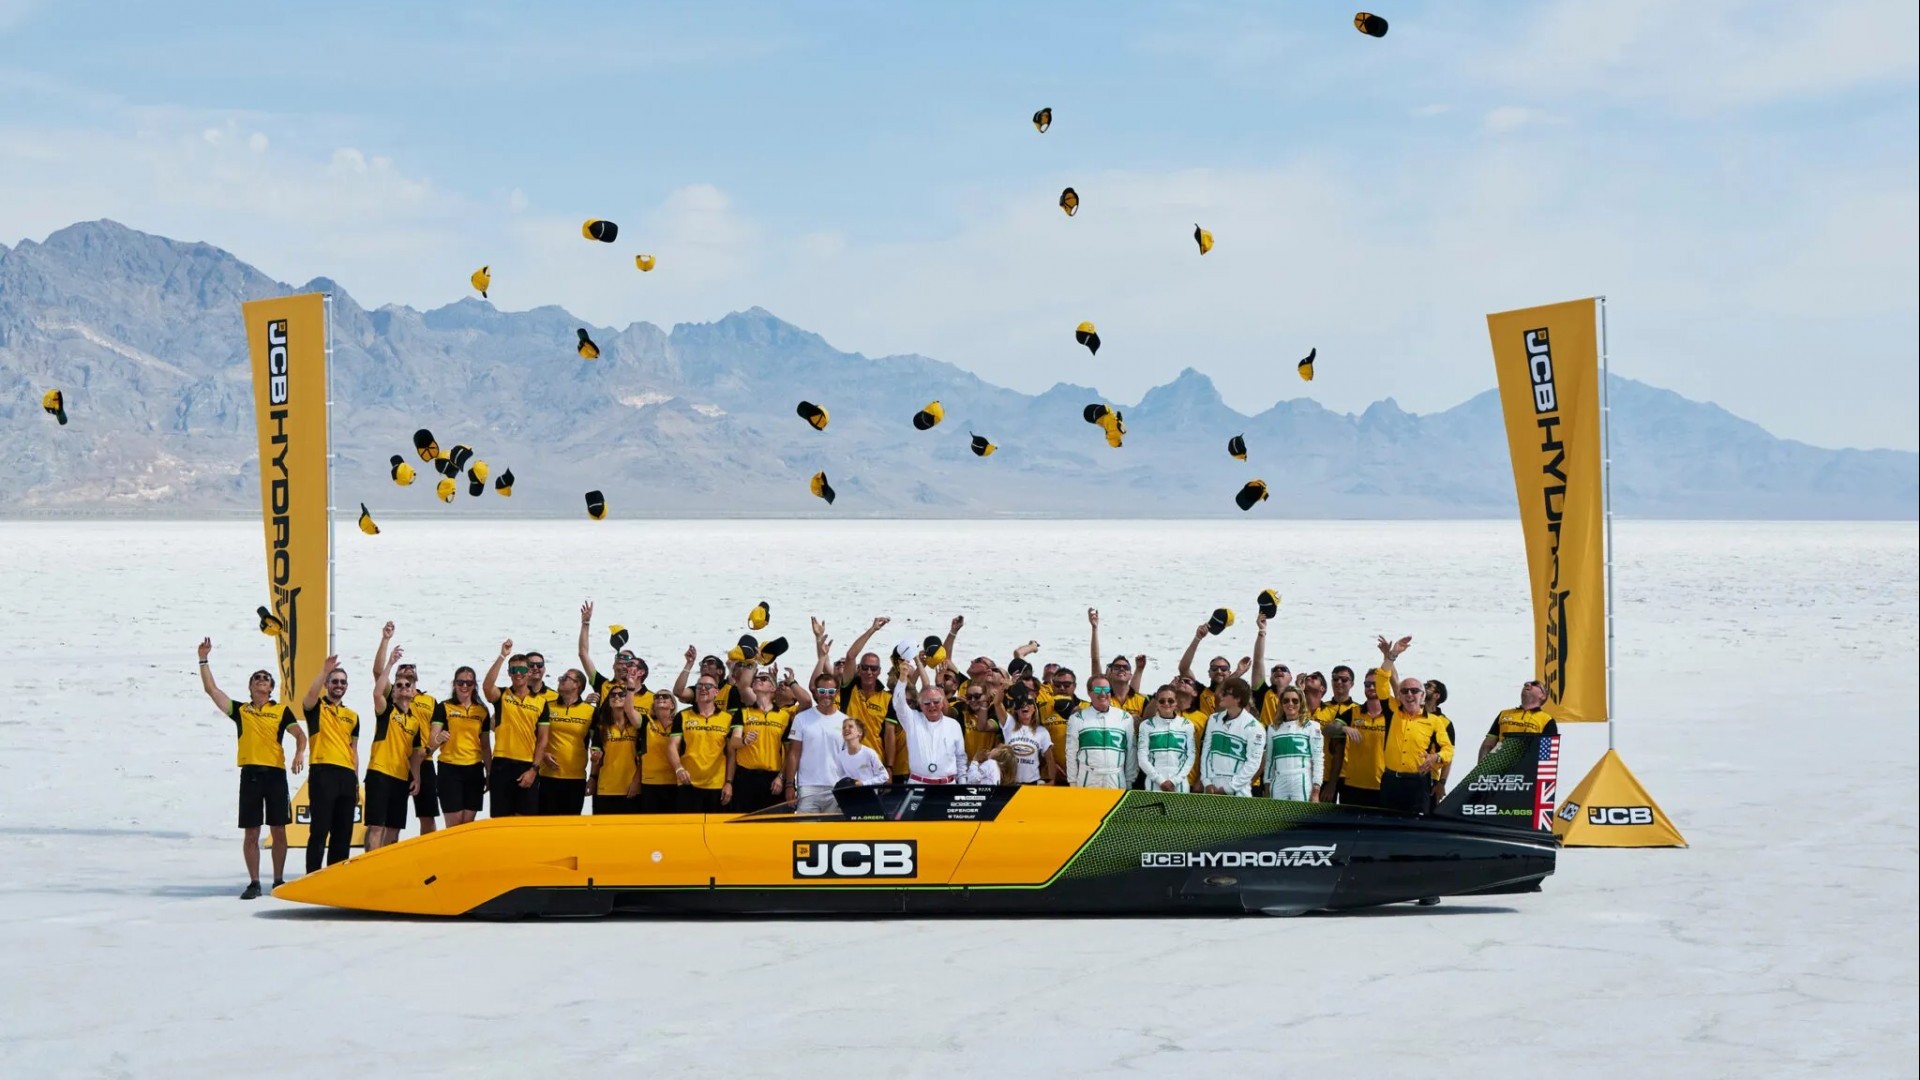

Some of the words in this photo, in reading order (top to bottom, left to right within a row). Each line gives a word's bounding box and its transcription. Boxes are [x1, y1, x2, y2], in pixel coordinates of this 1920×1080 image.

[269, 322, 287, 404] JCB
[1526, 331, 1556, 412] JCB
[1468, 783, 1533, 791] CONTENT
[1478, 775, 1525, 783] NEVER
[1590, 808, 1652, 824] JCB
[797, 843, 913, 875] JCB
[1143, 853, 1185, 866] JCB
[1187, 851, 1334, 867] HYDROMAX
